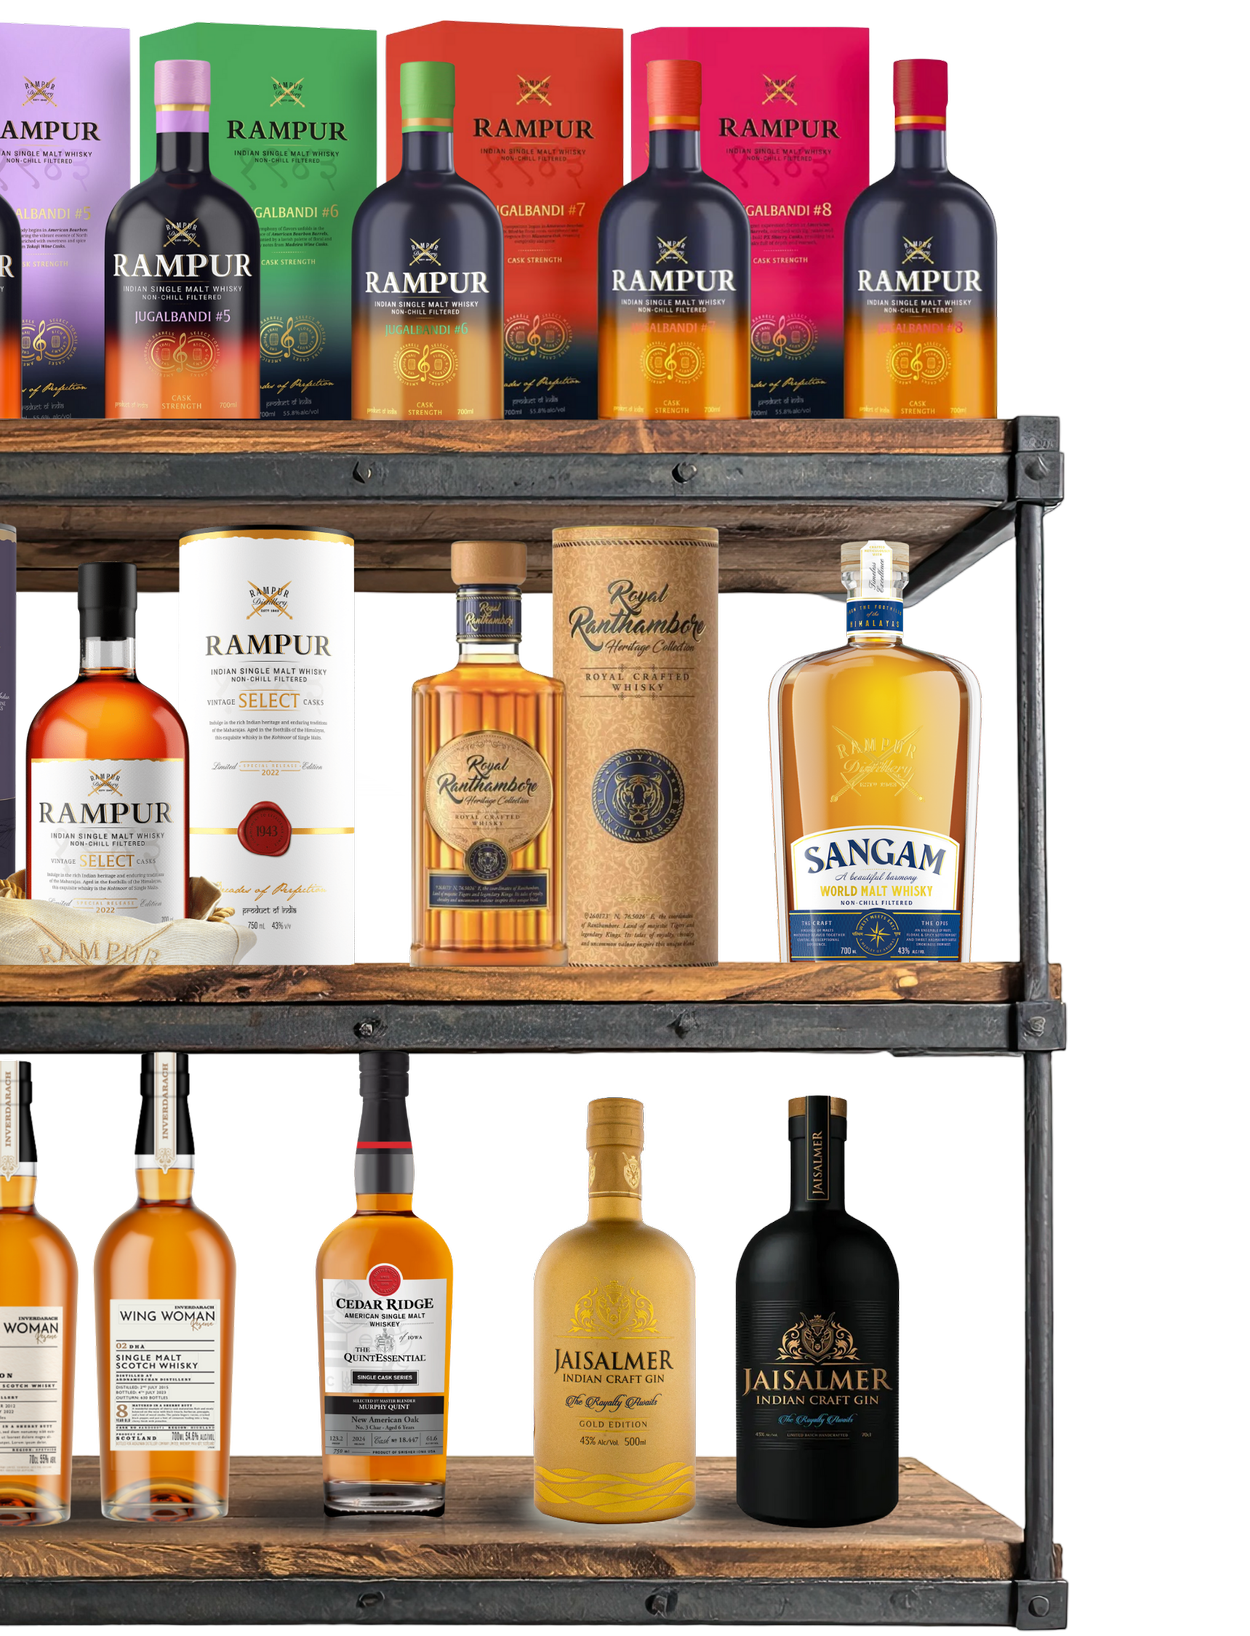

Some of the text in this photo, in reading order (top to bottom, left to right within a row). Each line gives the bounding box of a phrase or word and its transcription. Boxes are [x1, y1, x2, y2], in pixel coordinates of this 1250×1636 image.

[226, 120, 349, 141] RAMPUR
[473, 118, 595, 139] RAMPUR
[719, 117, 841, 139] RAMPUR
[113, 253, 252, 277] RAMPUR
[365, 271, 489, 293] RAMPUR
[612, 269, 737, 292] RAMPUR
[858, 270, 982, 292] RAMPUR
[135, 309, 231, 324] JUGALBANDI #5
[385, 322, 468, 337] JUGALBANDI #6
[608, 579, 669, 615] Royal
[569, 605, 706, 652] Ranthambore
[849, 620, 900, 628] HIMALAYAS
[205, 634, 332, 657] RAMPUR
[604, 639, 695, 657] Heritage Collection
[585, 673, 690, 681] ROYAL CRAFTED
[612, 683, 665, 691] WHISKY
[239, 693, 300, 708] SELECT
[211, 762, 323, 771] Limited Edition
[467, 755, 509, 780] Royal
[437, 773, 538, 804] Ranthambore
[464, 796, 529, 807] Heritage Collection
[39, 802, 173, 824] RAMPUR
[256, 826, 278, 837] 1943
[79, 854, 135, 868] SELECT
[804, 838, 947, 875] SANGAM
[835, 872, 918, 884] A beautiful harmony
[820, 885, 933, 897] WORLD MALT WHISKY
[812, 1130, 825, 1195] JAISALMER
[336, 1298, 434, 1311] CEDAR RIDGE
[120, 1311, 215, 1321] WING WOMAN
[4, 1322, 59, 1334] WOMAN
[554, 1349, 674, 1374] JAISALMER
[563, 1374, 665, 1383] INDIAN CRAFT GIN
[742, 1368, 893, 1397] JAISALMER
[565, 1393, 662, 1413] The Royalty Awaits
[756, 1395, 879, 1405] INDIAN CRAFT GIN
[579, 1420, 604, 1428] GOLD
[580, 1436, 646, 1446] 43% 500ml
